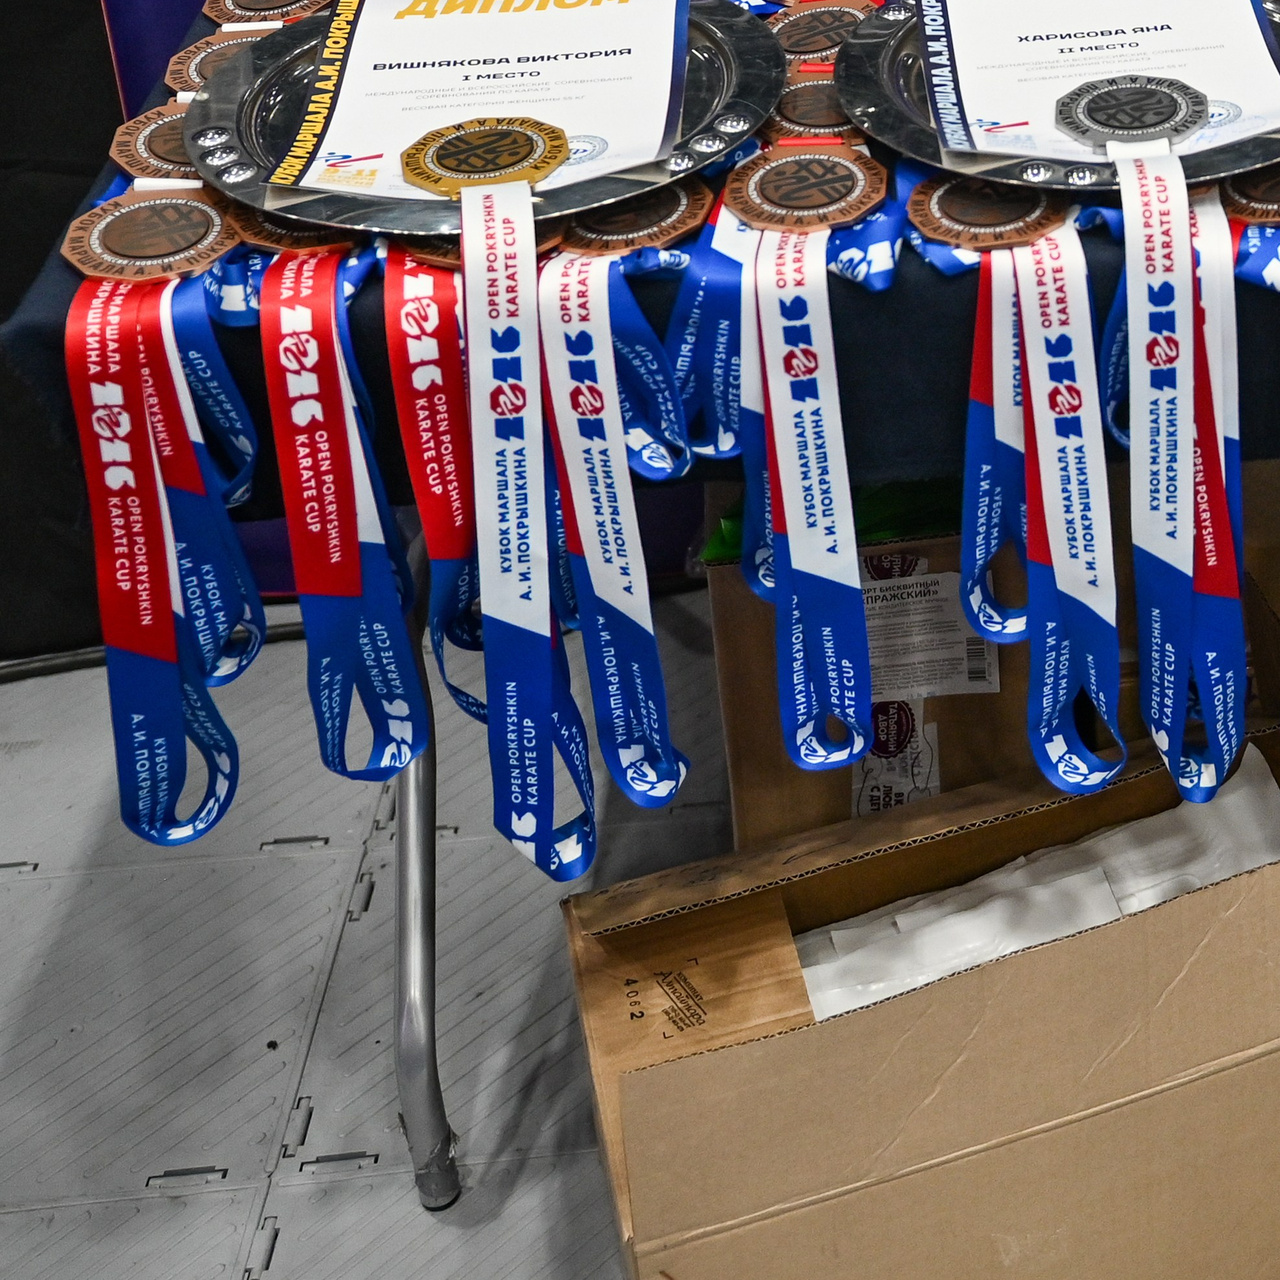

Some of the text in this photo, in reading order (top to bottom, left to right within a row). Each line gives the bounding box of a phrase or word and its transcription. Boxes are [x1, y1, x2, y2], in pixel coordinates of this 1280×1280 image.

[373, 47, 632, 71] ВИШНЯКОВА ВИКТОРИЯ
[1017, 23, 1172, 43] ХАРИСОВА ЯНА
[1080, 42, 1139, 51] МЕСТО
[365, 76, 632, 97] МЕЖДУНАРОДНЫЕ ВСЕРОССИЙСКИЕ СОРЕВНОВАНИЯ
[416, 86, 551, 100] СОРЕВНОВАНИЯ КАРАТЭ
[450, 99, 504, 109] КАТЕГОРИЯ
[507, 96, 560, 105] ЖЕНЩИНЫ
[477, 70, 540, 80] МЕСТО
[932, 67, 965, 126] МАРШАЛА
[269, 156, 303, 185] КУБОК
[291, 92, 333, 157] МАРШАЛА
[485, 193, 501, 320] OPEN POKRYSHKIN
[502, 216, 520, 318] KARATE CUP
[1145, 232, 1156, 275] OPEN
[1160, 207, 1175, 273] KARATE
[105, 296, 123, 373] МАРШАЛА
[561, 286, 573, 323] OPEN
[294, 434, 321, 534] KARATE CUP
[415, 398, 442, 495] KARATE CUP
[440, 432, 464, 527] POKRYSHKIN
[796, 410, 813, 482] МАРШАЛА
[812, 407, 833, 518] ПОКРЫШКИНА
[1147, 397, 1162, 512] КУБОК МАРШАЛА
[1164, 396, 1178, 497] ПОКРЫШКИНА
[314, 430, 341, 563] OPEN POKRYSHKIN
[513, 446, 530, 565] ПОКРЫШКИНА
[114, 558, 131, 591] CUP
[132, 534, 153, 625] POKRYSHKIN
[879, 580, 940, 593] БИСКВИТНЫЙ
[603, 647, 627, 743] ПОКРЫШКИНА
[1150, 607, 1162, 719] OPEN POKRYSHKIN
[1163, 642, 1176, 726] KARATE CUP
[505, 681, 523, 804] OPEN POKRYSHKIN
[522, 717, 539, 806] KARATE CUP
[878, 714, 887, 741] ДВОР
[888, 703, 898, 751] ТАТЬЯНИН
[623, 978, 645, 1022] 4062
